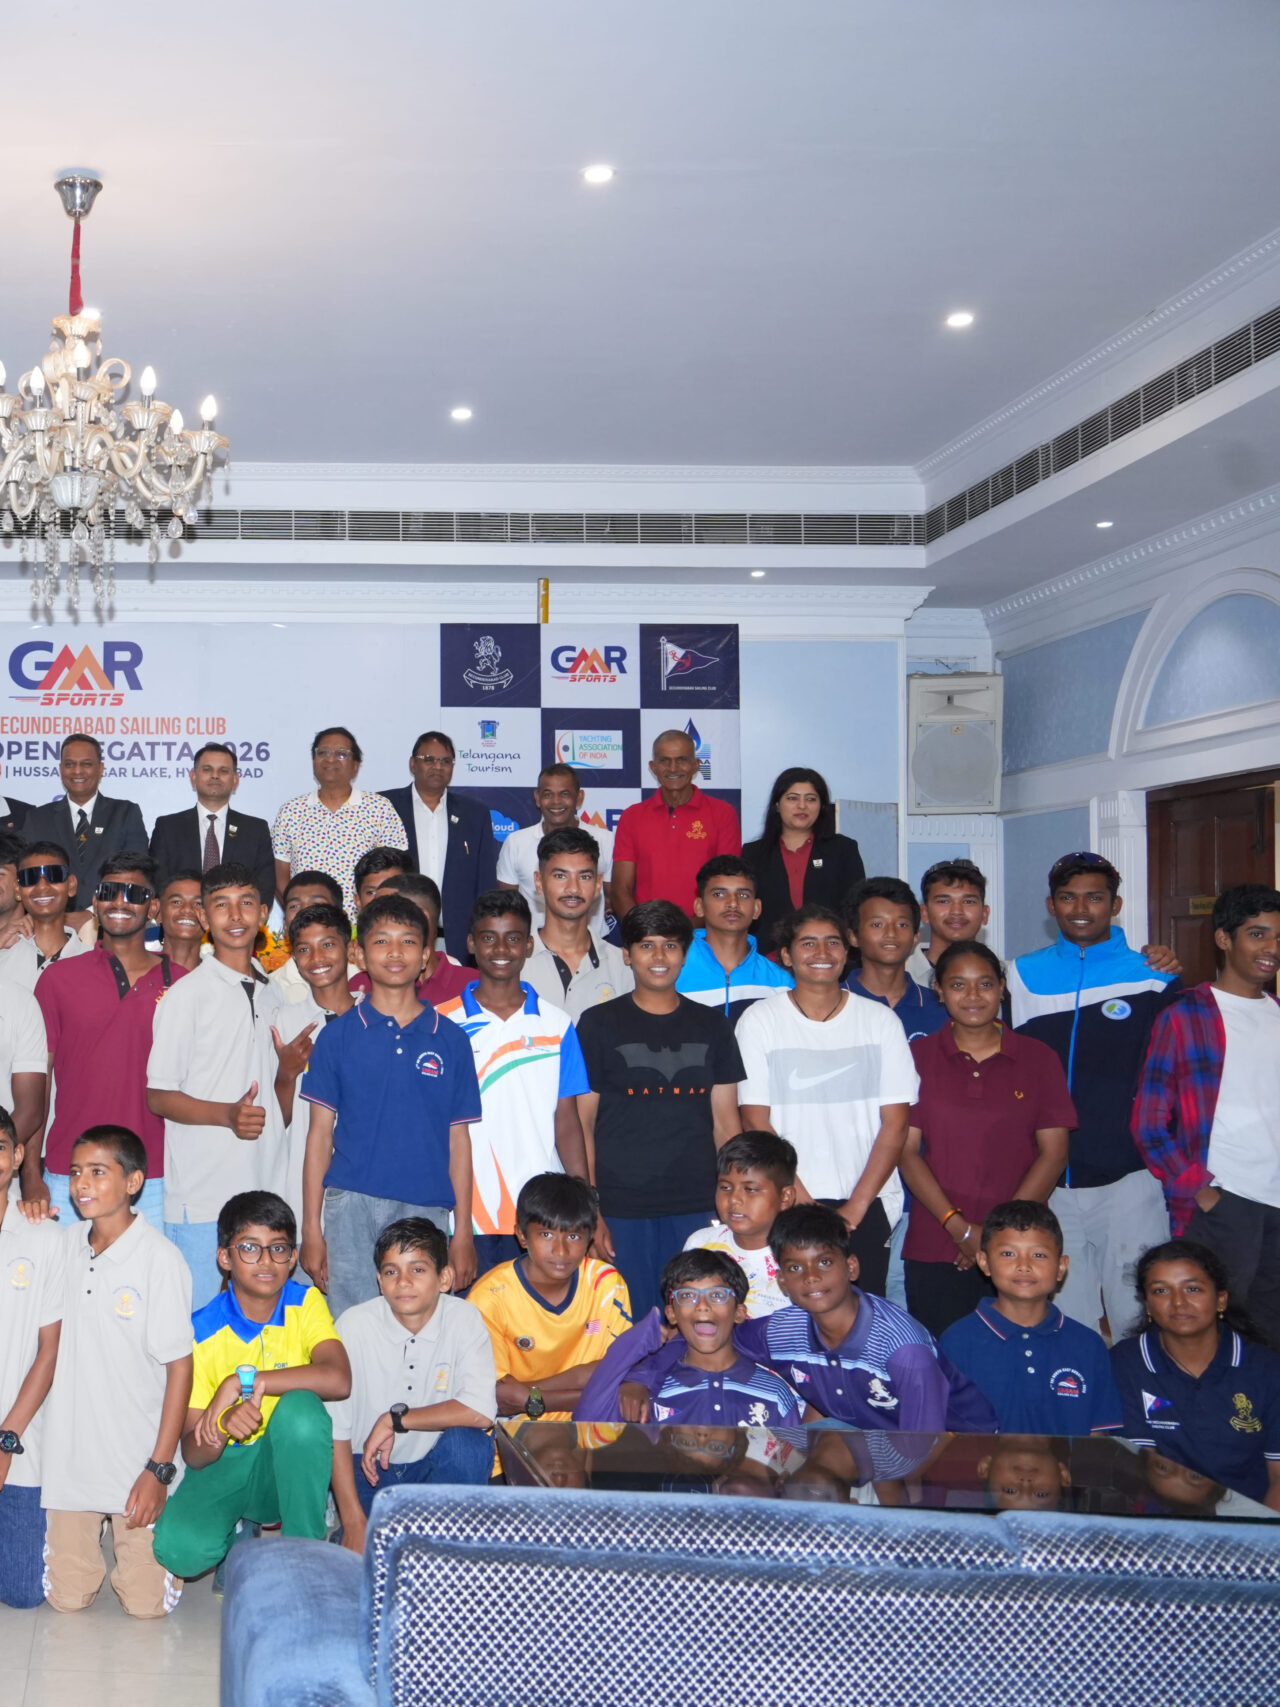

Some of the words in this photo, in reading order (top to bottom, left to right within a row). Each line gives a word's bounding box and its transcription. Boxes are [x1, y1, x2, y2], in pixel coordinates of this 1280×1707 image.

[568, 674, 617, 683] SPORTS
[40, 692, 125, 706] SPORTS
[120, 716, 181, 735] SAILING
[186, 717, 227, 735] CLUB
[579, 735, 613, 743] YACHTING
[579, 743, 623, 751] ASSOCIATION
[458, 748, 521, 763] Telangana
[589, 752, 608, 760] INDIA
[12, 766, 60, 777] HUSSA
[131, 767, 172, 779] LAKE,
[464, 763, 513, 774] Tourism
[492, 822, 515, 832] loud
